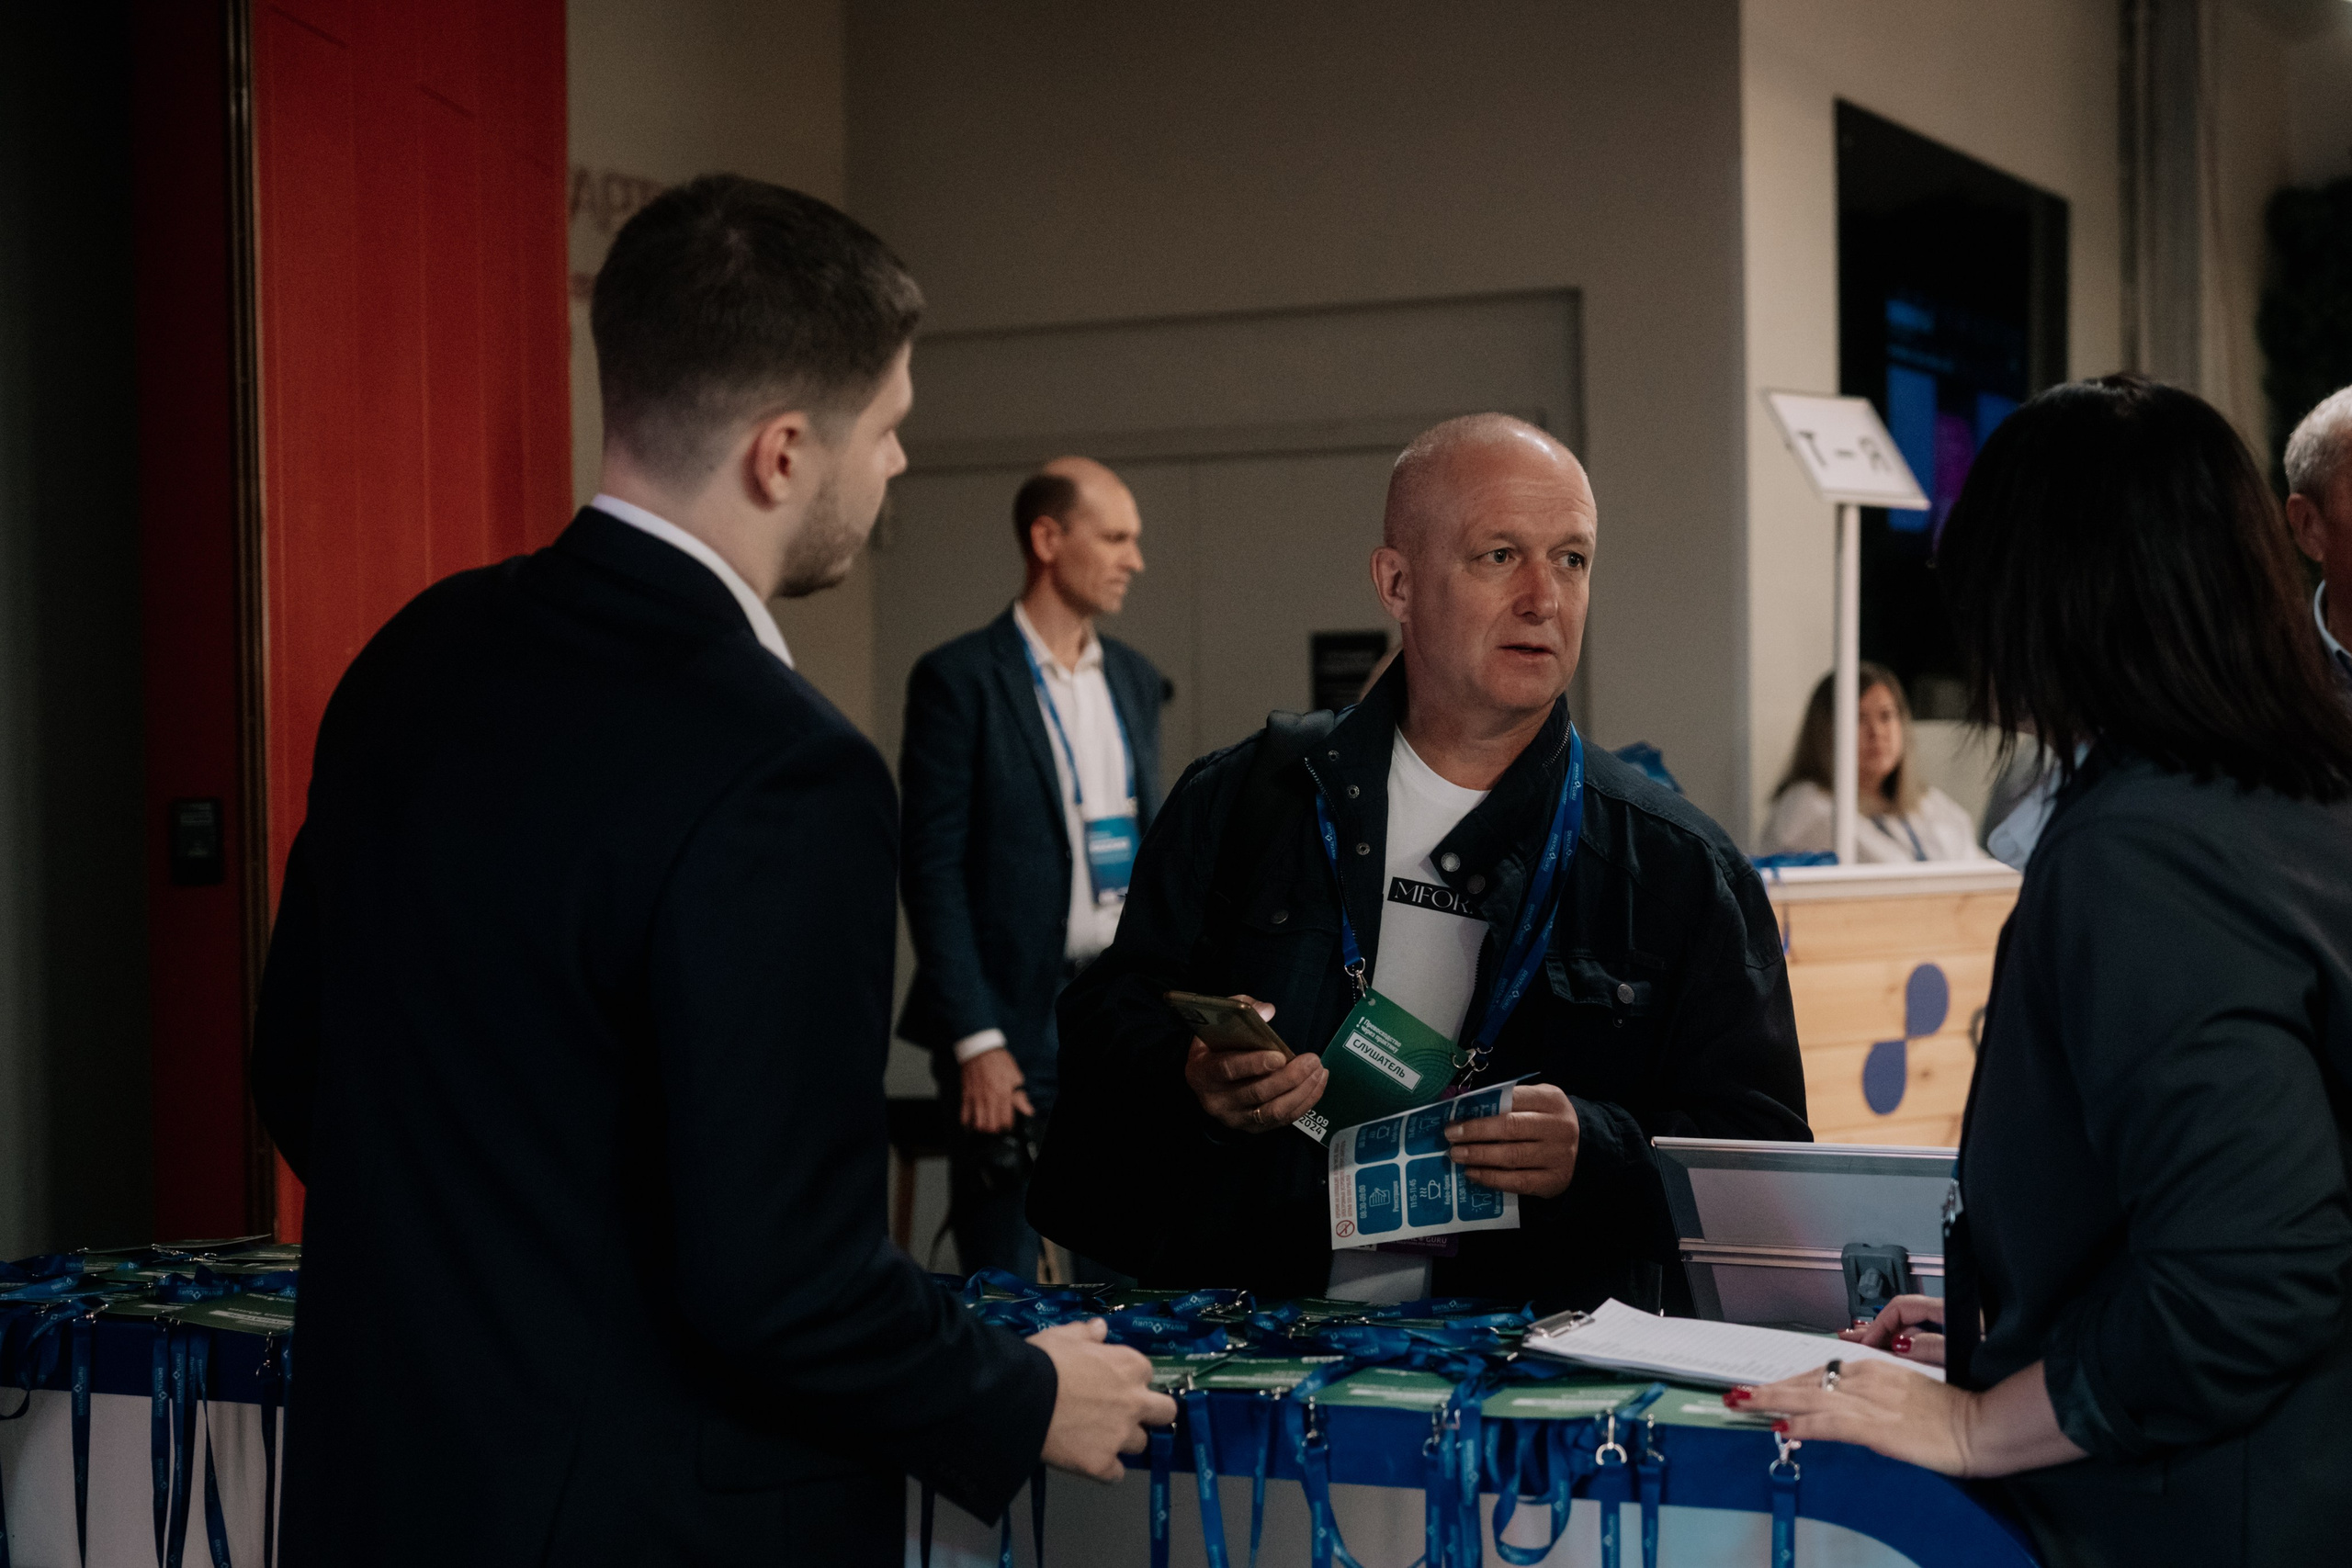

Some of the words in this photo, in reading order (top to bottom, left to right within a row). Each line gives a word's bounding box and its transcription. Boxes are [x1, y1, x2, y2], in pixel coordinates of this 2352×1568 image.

[1363, 1019, 1402, 1047] Превосходство
[1352, 1039, 1406, 1078] СЛУШАТЕЛЬ
[1298, 1115, 1322, 1135] 2024
[1425, 1236, 1448, 1245] GURU
